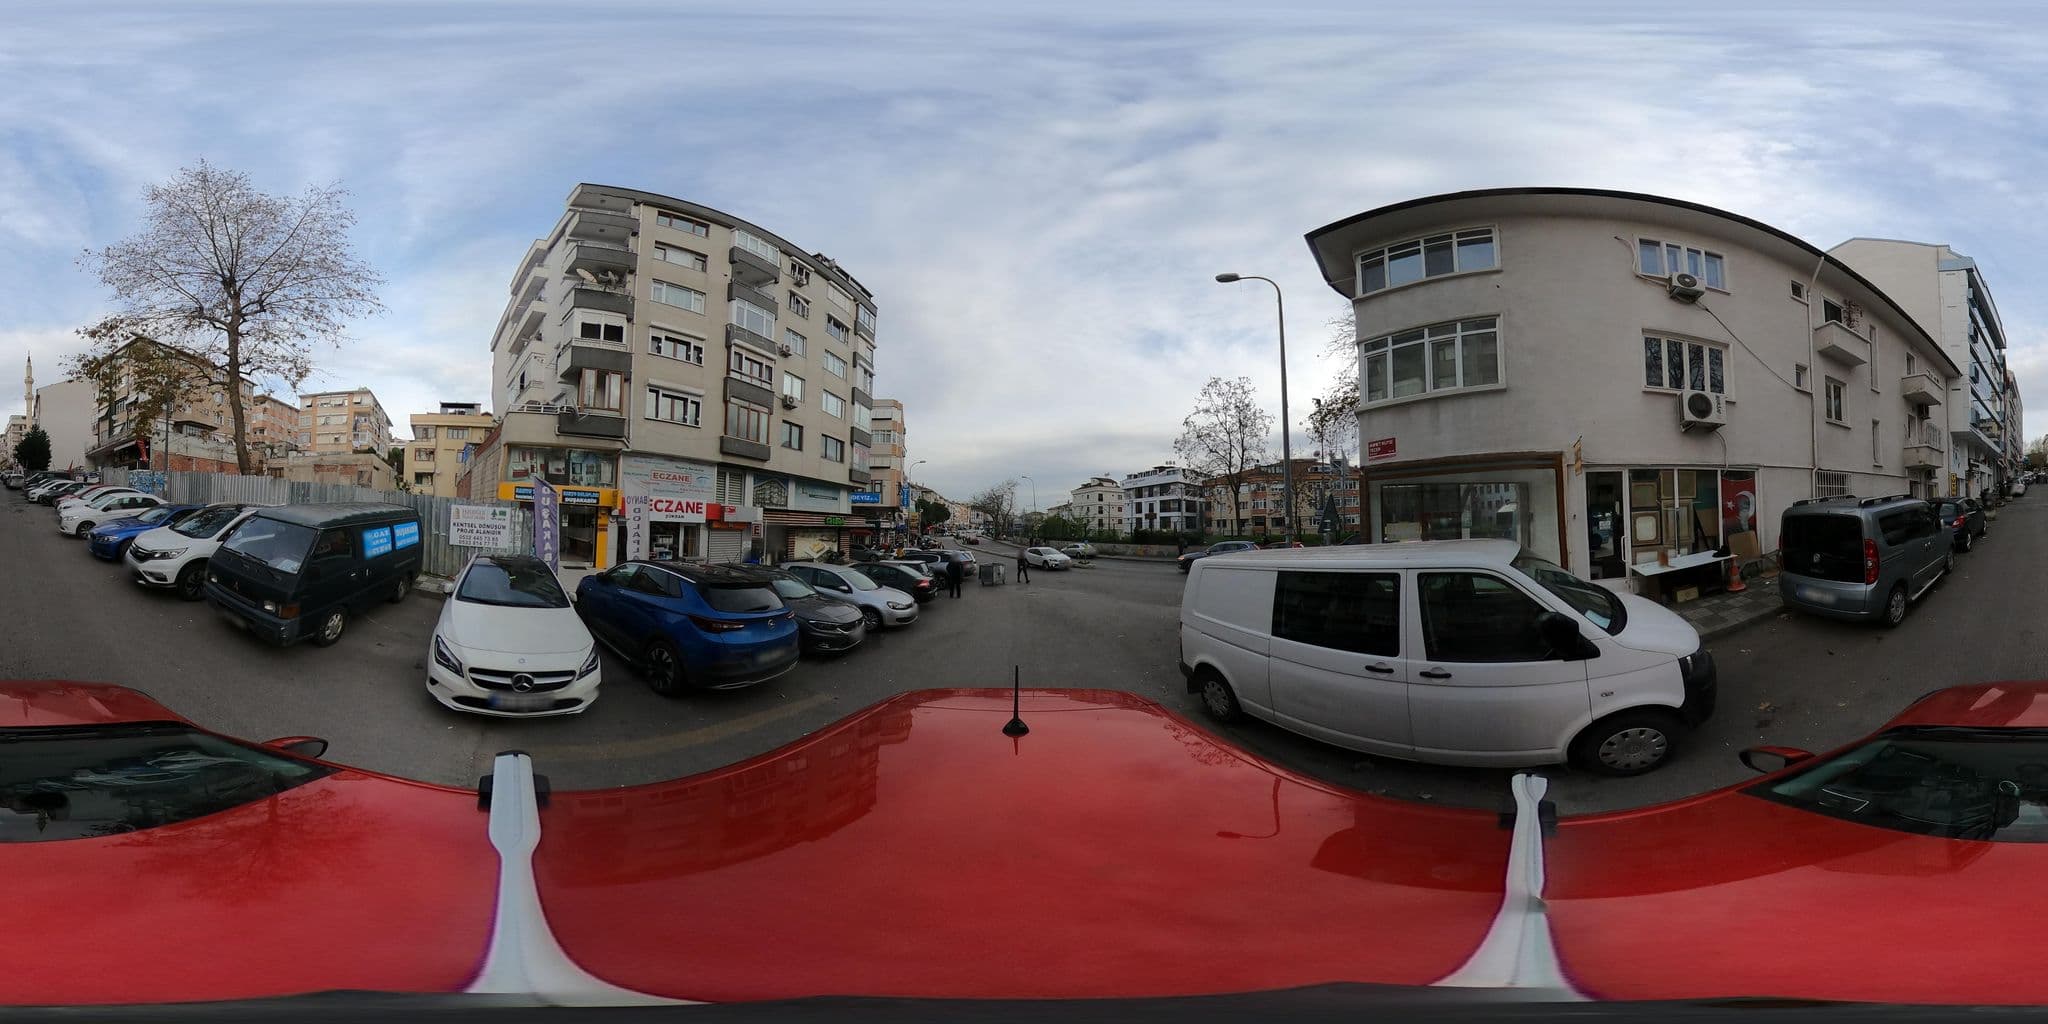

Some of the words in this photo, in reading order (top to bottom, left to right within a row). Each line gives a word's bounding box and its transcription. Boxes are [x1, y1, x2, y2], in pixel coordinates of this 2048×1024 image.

[653, 472, 690, 483] ECZANE
[541, 486, 553, 564] DUŞAKAB
[754, 526, 759, 535] E
